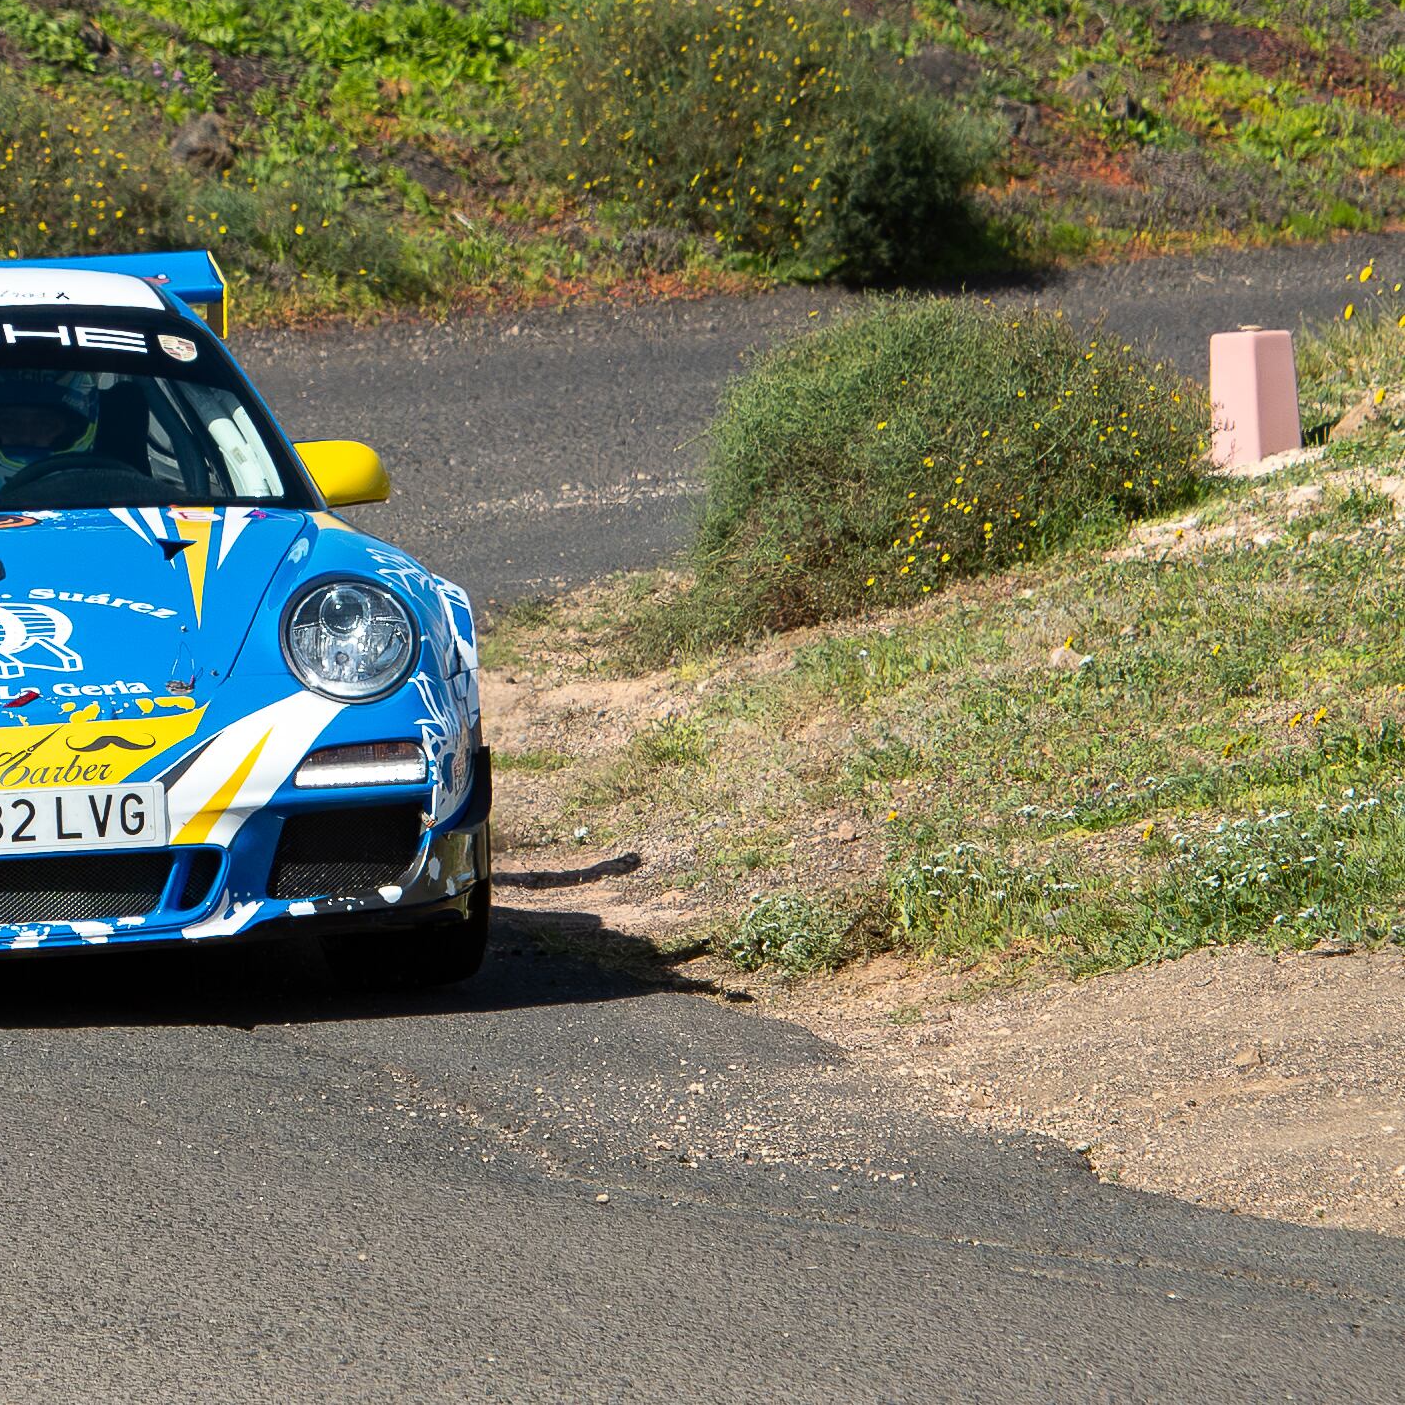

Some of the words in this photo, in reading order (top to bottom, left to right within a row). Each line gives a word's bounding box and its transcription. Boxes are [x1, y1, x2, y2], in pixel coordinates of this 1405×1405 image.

[28, 588, 179, 621] Suárez
[52, 679, 152, 700] Geria
[55, 792, 146, 840] LVG
